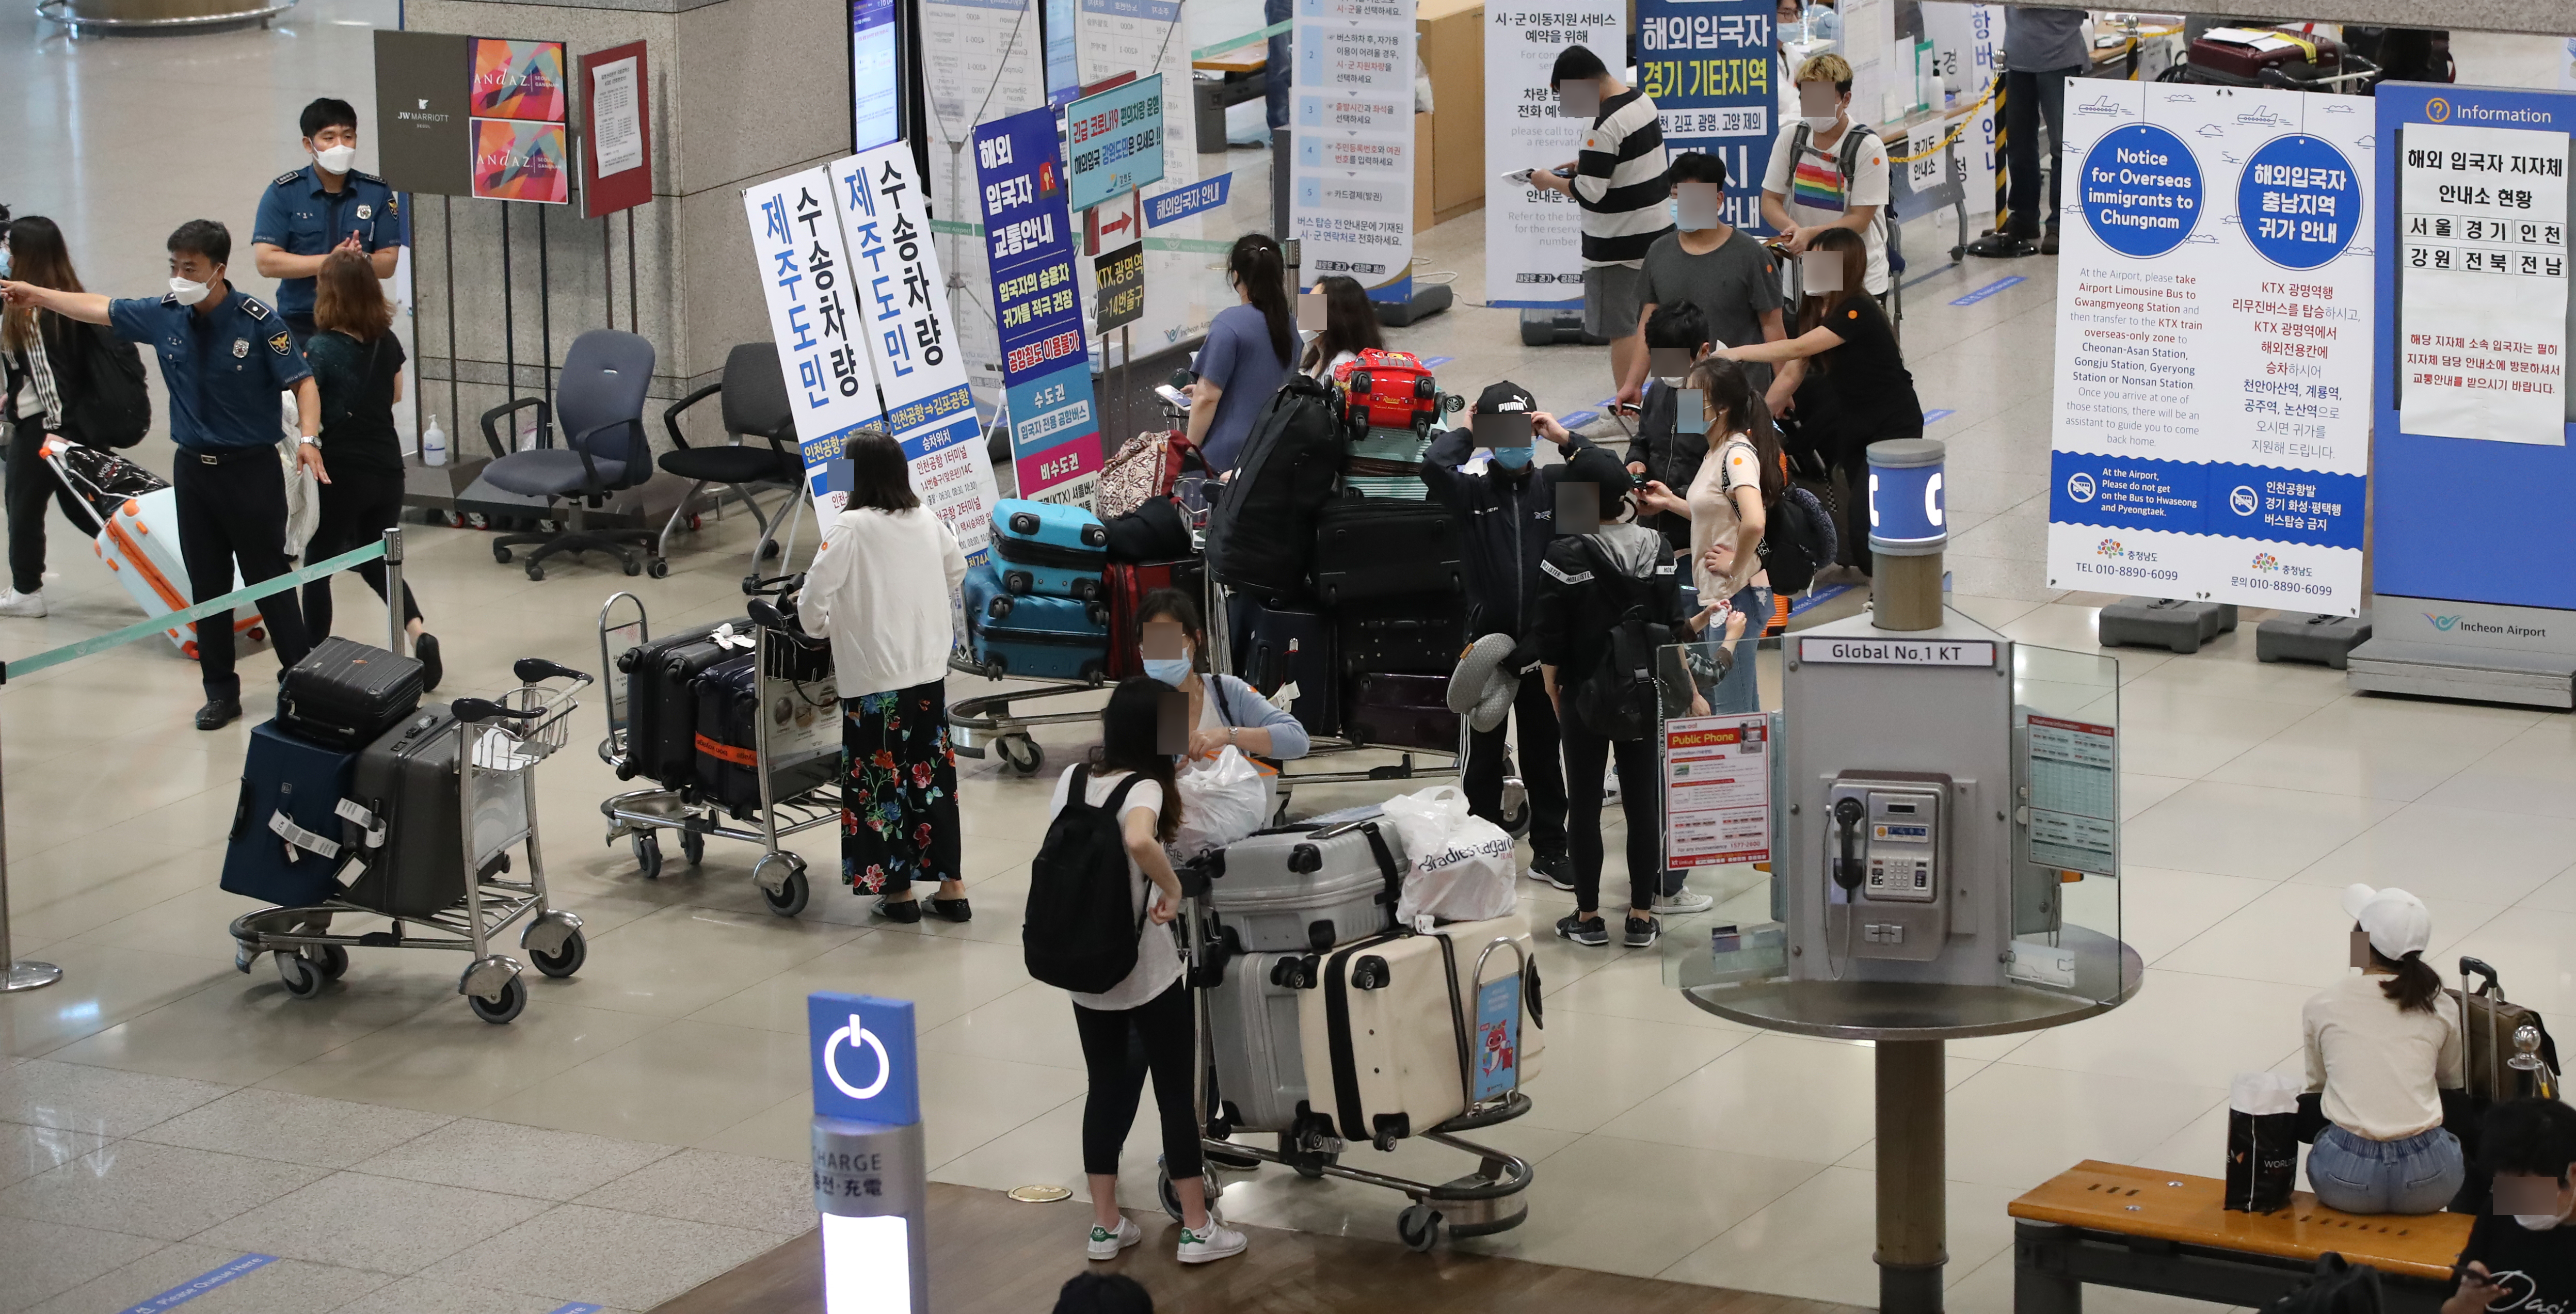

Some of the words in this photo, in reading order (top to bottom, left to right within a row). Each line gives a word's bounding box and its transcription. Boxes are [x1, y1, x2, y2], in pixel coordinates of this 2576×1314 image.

[1495, 13, 1527, 26] 시·군
[1529, 12, 1578, 27] 이동지원
[1580, 13, 1617, 27] 서비스
[1525, 29, 1562, 43] 예약을
[1564, 30, 1589, 43] 위해
[1642, 14, 1771, 51] 해외입국자
[1336, 74, 1371, 84] 선택하세요
[1643, 60, 1683, 99] 경기
[1689, 58, 1767, 97] 기타지역
[1524, 88, 1549, 102] 차량
[411, 112, 449, 122] MARRIOTT
[1073, 119, 1087, 144] 긴급
[1090, 108, 1118, 139] 코로나19
[1121, 100, 1145, 127] 편의차량
[1147, 94, 1160, 117] 운행
[1517, 104, 1543, 118] 전화
[1722, 113, 1741, 131] 고양
[1743, 112, 1761, 130] 제외
[2457, 105, 2552, 124] Information
[1511, 126, 1542, 138] please
[1544, 126, 1561, 136] call
[1563, 127, 1573, 136] to
[979, 134, 1013, 169] 해외
[1075, 148, 1100, 175] 해외입국
[1102, 135, 1135, 166] 강원도민은
[1136, 128, 1155, 152] 오세요
[2117, 148, 2168, 166] Notice
[1913, 161, 1935, 182] 안내소
[2408, 149, 2443, 170] 해외
[2451, 151, 2503, 173] 입국자
[2510, 155, 2563, 178] 지자체
[2091, 167, 2116, 183] for
[2120, 168, 2192, 188] Overseas
[2254, 163, 2347, 191] 해외입국자
[986, 173, 1033, 216] 입국자
[1156, 190, 1200, 221] 해외입국자
[1201, 182, 1220, 203] 안내
[1334, 190, 1383, 203] 카드결제(발권)
[1526, 190, 1563, 203] 안내문
[2088, 187, 2172, 208] immigrants
[2177, 194, 2194, 209] to
[2262, 191, 2336, 217] 충남지역
[2439, 184, 2491, 205] 안내소
[2498, 188, 2533, 210] 현황
[1298, 216, 1314, 227] 버스
[1316, 216, 1333, 229] 탑승
[1334, 219, 1342, 230] 전
[1343, 219, 1377, 232] 안내문에
[1379, 221, 1404, 233] 기재된
[2100, 209, 2180, 230] Chungnam
[992, 213, 1054, 259] 교통안내
[1300, 230, 1322, 242] 시·군
[1322, 231, 1356, 244] 연락처로
[1358, 233, 1403, 247] 전화하세요.
[2258, 217, 2296, 241] 귀가
[2300, 221, 2338, 244] 안내
[1539, 236, 1577, 247] number
[844, 166, 914, 378] 제주도민
[880, 160, 943, 366] 수송차량
[999, 271, 1038, 303] 입국자의
[1039, 262, 1070, 289] 승용차
[2080, 268, 2090, 277] At
[2093, 269, 2107, 278] the
[2109, 270, 2142, 282] Airport,
[2145, 272, 2172, 283] please
[2175, 275, 2196, 284] take
[761, 193, 829, 409] 제주도민
[797, 187, 858, 397] 수송차량
[2079, 283, 2113, 294] Airport
[2116, 285, 2163, 297] Limousine
[2166, 289, 2183, 299] Bus
[2186, 291, 2196, 299] to
[2262, 282, 2285, 294] KTX
[2289, 284, 2333, 300] 광명역행
[1002, 302, 1031, 329] 귀가를
[1031, 294, 1052, 318] 적극
[1052, 289, 1074, 309] 권장
[1108, 288, 1143, 318] 14번출구
[2232, 299, 2299, 317] 리무진버스를
[2302, 305, 2361, 323] 탑승하시고,
[1180, 324, 1200, 337] Incheon
[1007, 341, 1044, 374] 공항철도
[1043, 329, 1080, 360] 이용불가
[2082, 342, 2149, 356] Cheonan-Asan
[2152, 347, 2188, 360] Station,
[2261, 341, 2328, 359] 해외전용칸에
[2410, 333, 2431, 346] 해당
[2435, 335, 2465, 349] 지자체
[2469, 339, 2489, 350] 소속
[2492, 340, 2533, 355] 입국자는
[2537, 343, 2558, 356] 필히
[2407, 353, 2438, 366] 지자체
[2442, 356, 2462, 367] 담당
[2465, 357, 2506, 371] 안내소에
[2510, 361, 2561, 376] 방문하셔서
[1034, 383, 1065, 409] 수도권
[2244, 379, 2302, 397] 천안아산역,
[2306, 385, 2343, 401] 계룡역,
[1498, 402, 1525, 413] PUMA
[1020, 421, 1042, 440] 입국자
[1042, 415, 1058, 431] 전용
[1058, 405, 1086, 427] 공항버스
[922, 428, 952, 452] 승차위치
[917, 453, 943, 475] 인천공항
[945, 444, 968, 464] 1터미널
[1040, 452, 1079, 480] 비수도권
[2102, 479, 2127, 490] Please
[2129, 481, 2140, 491] do
[2142, 483, 2156, 492] not
[2157, 485, 2170, 493] get
[2266, 481, 2317, 498] 인천공항발
[956, 495, 982, 516] 2터미널
[2264, 514, 2305, 530] 버스탑승
[2307, 517, 2328, 532] 금지
[2127, 551, 2158, 562] 충청남도
[2076, 563, 2093, 573] TEL
[2095, 564, 2178, 581] 010-8890-6099
[2282, 565, 2313, 577] 충청남도
[2231, 576, 2248, 588] 문의
[2250, 579, 2332, 597] 010-8890-6099
[2461, 621, 2503, 634] Incheon
[2507, 625, 2546, 638] Airport
[1832, 644, 1890, 661] Global
[1895, 646, 1932, 662] No.1
[1939, 647, 1962, 661] KT
[1672, 735, 1701, 745] Public
[1704, 732, 1735, 744] Phone
[276, 821, 285, 831] ICN
[156, 1287, 198, 1305] Please
[193, 1271, 235, 1289] Queue
[231, 1258, 263, 1272] Here
